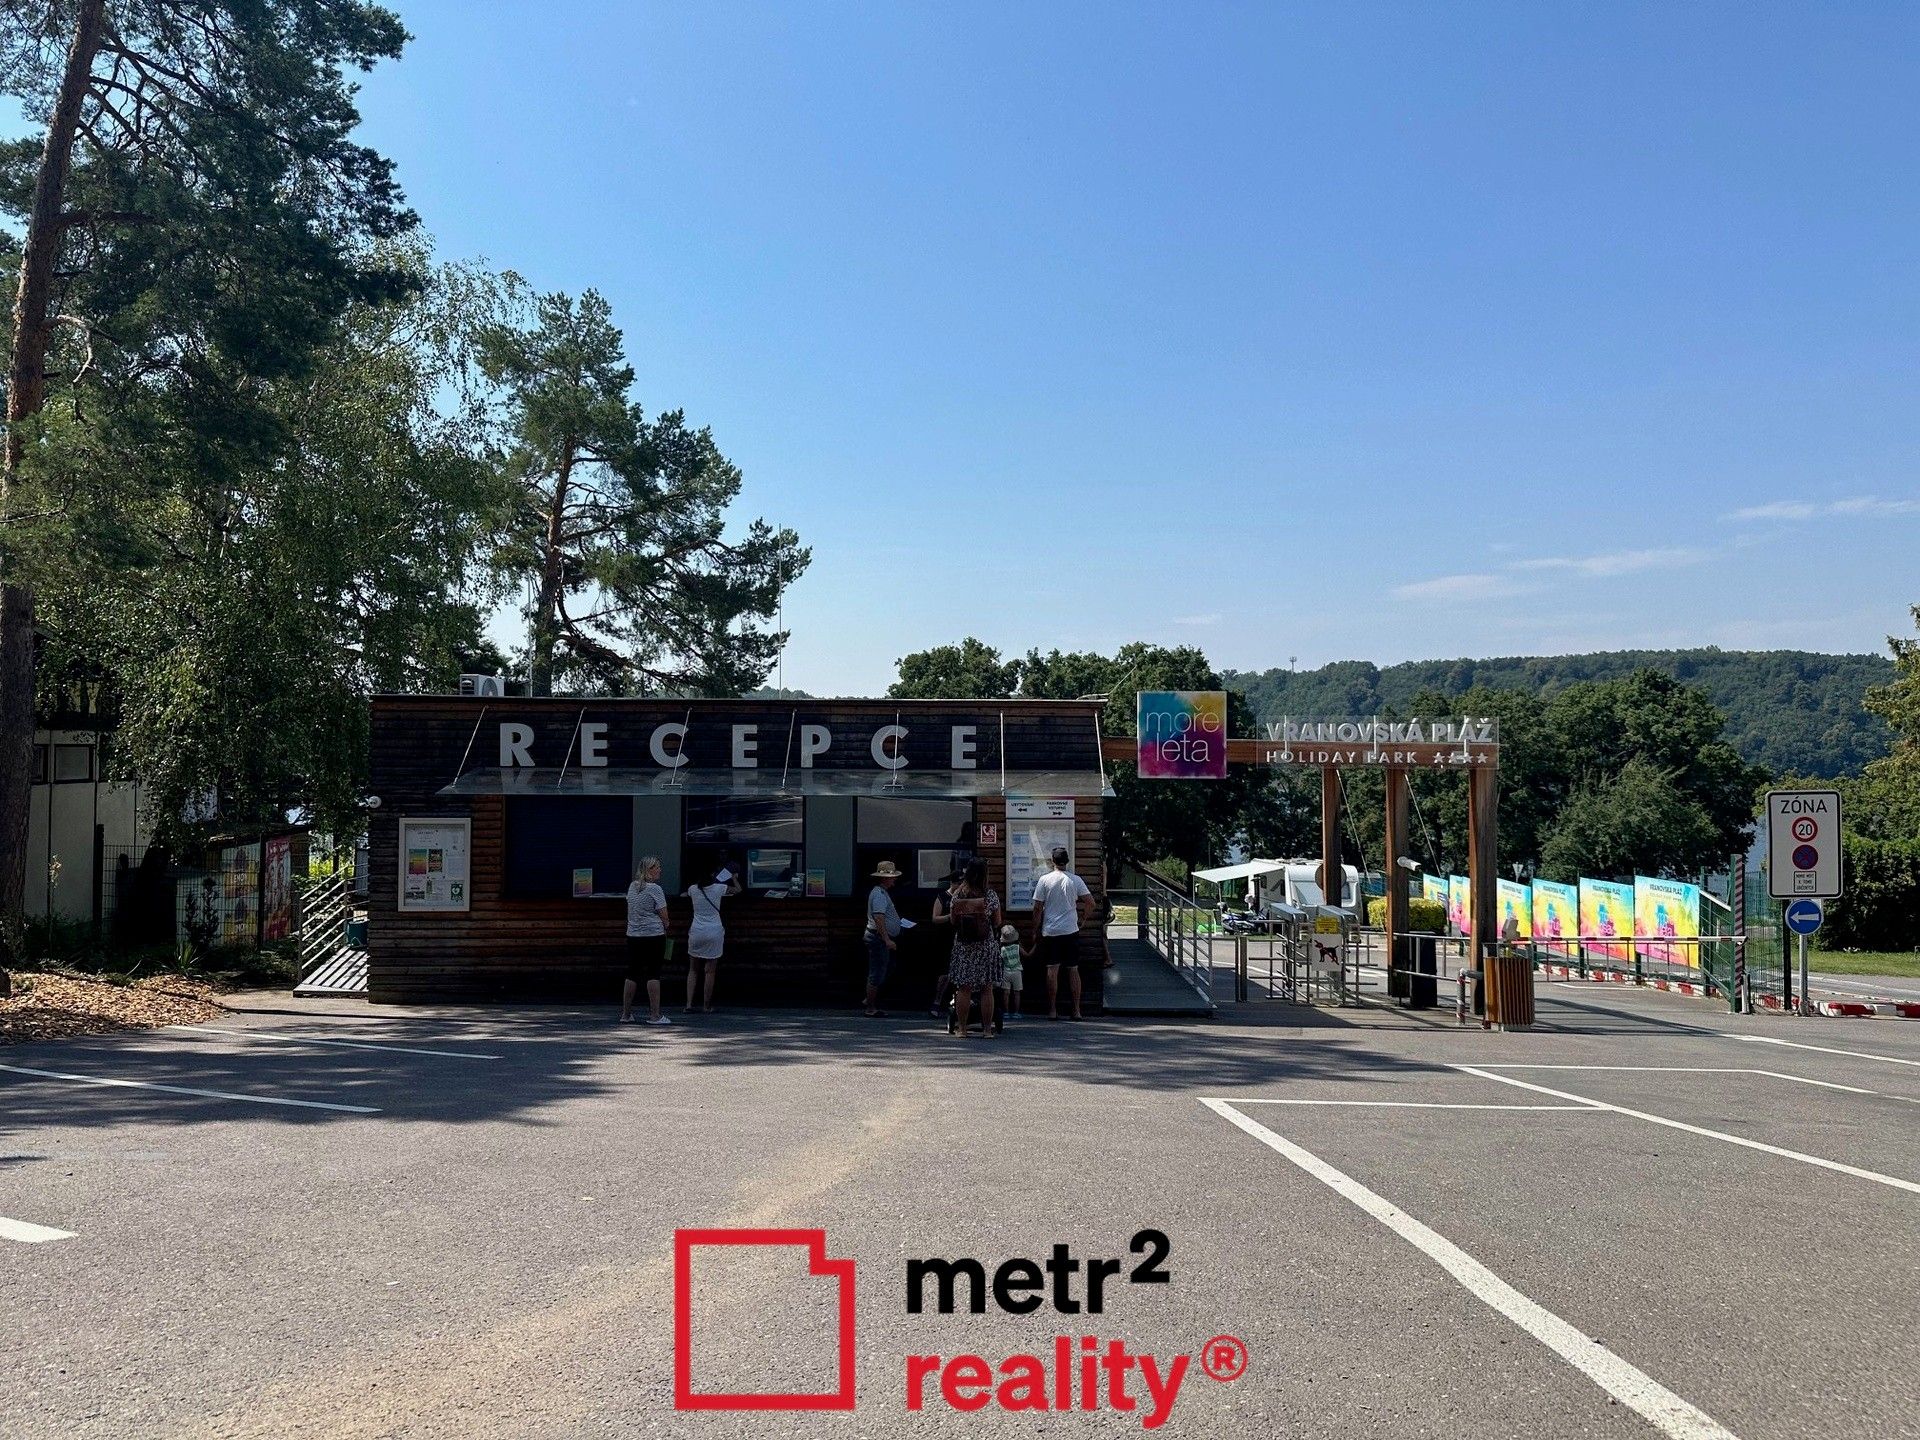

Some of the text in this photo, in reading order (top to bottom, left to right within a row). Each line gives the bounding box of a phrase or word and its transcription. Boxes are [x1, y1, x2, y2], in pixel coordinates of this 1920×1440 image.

[1146, 704, 1220, 733] moře
[1266, 718, 1493, 743] VRANOVSKÁ PLÁŽ
[499, 722, 977, 769] RECEPCE
[1156, 731, 1211, 763] léta
[1266, 750, 1418, 764] HOLIDAY PARK
[1780, 796, 1828, 814] ZÓNA
[1798, 823, 1813, 836] 20
